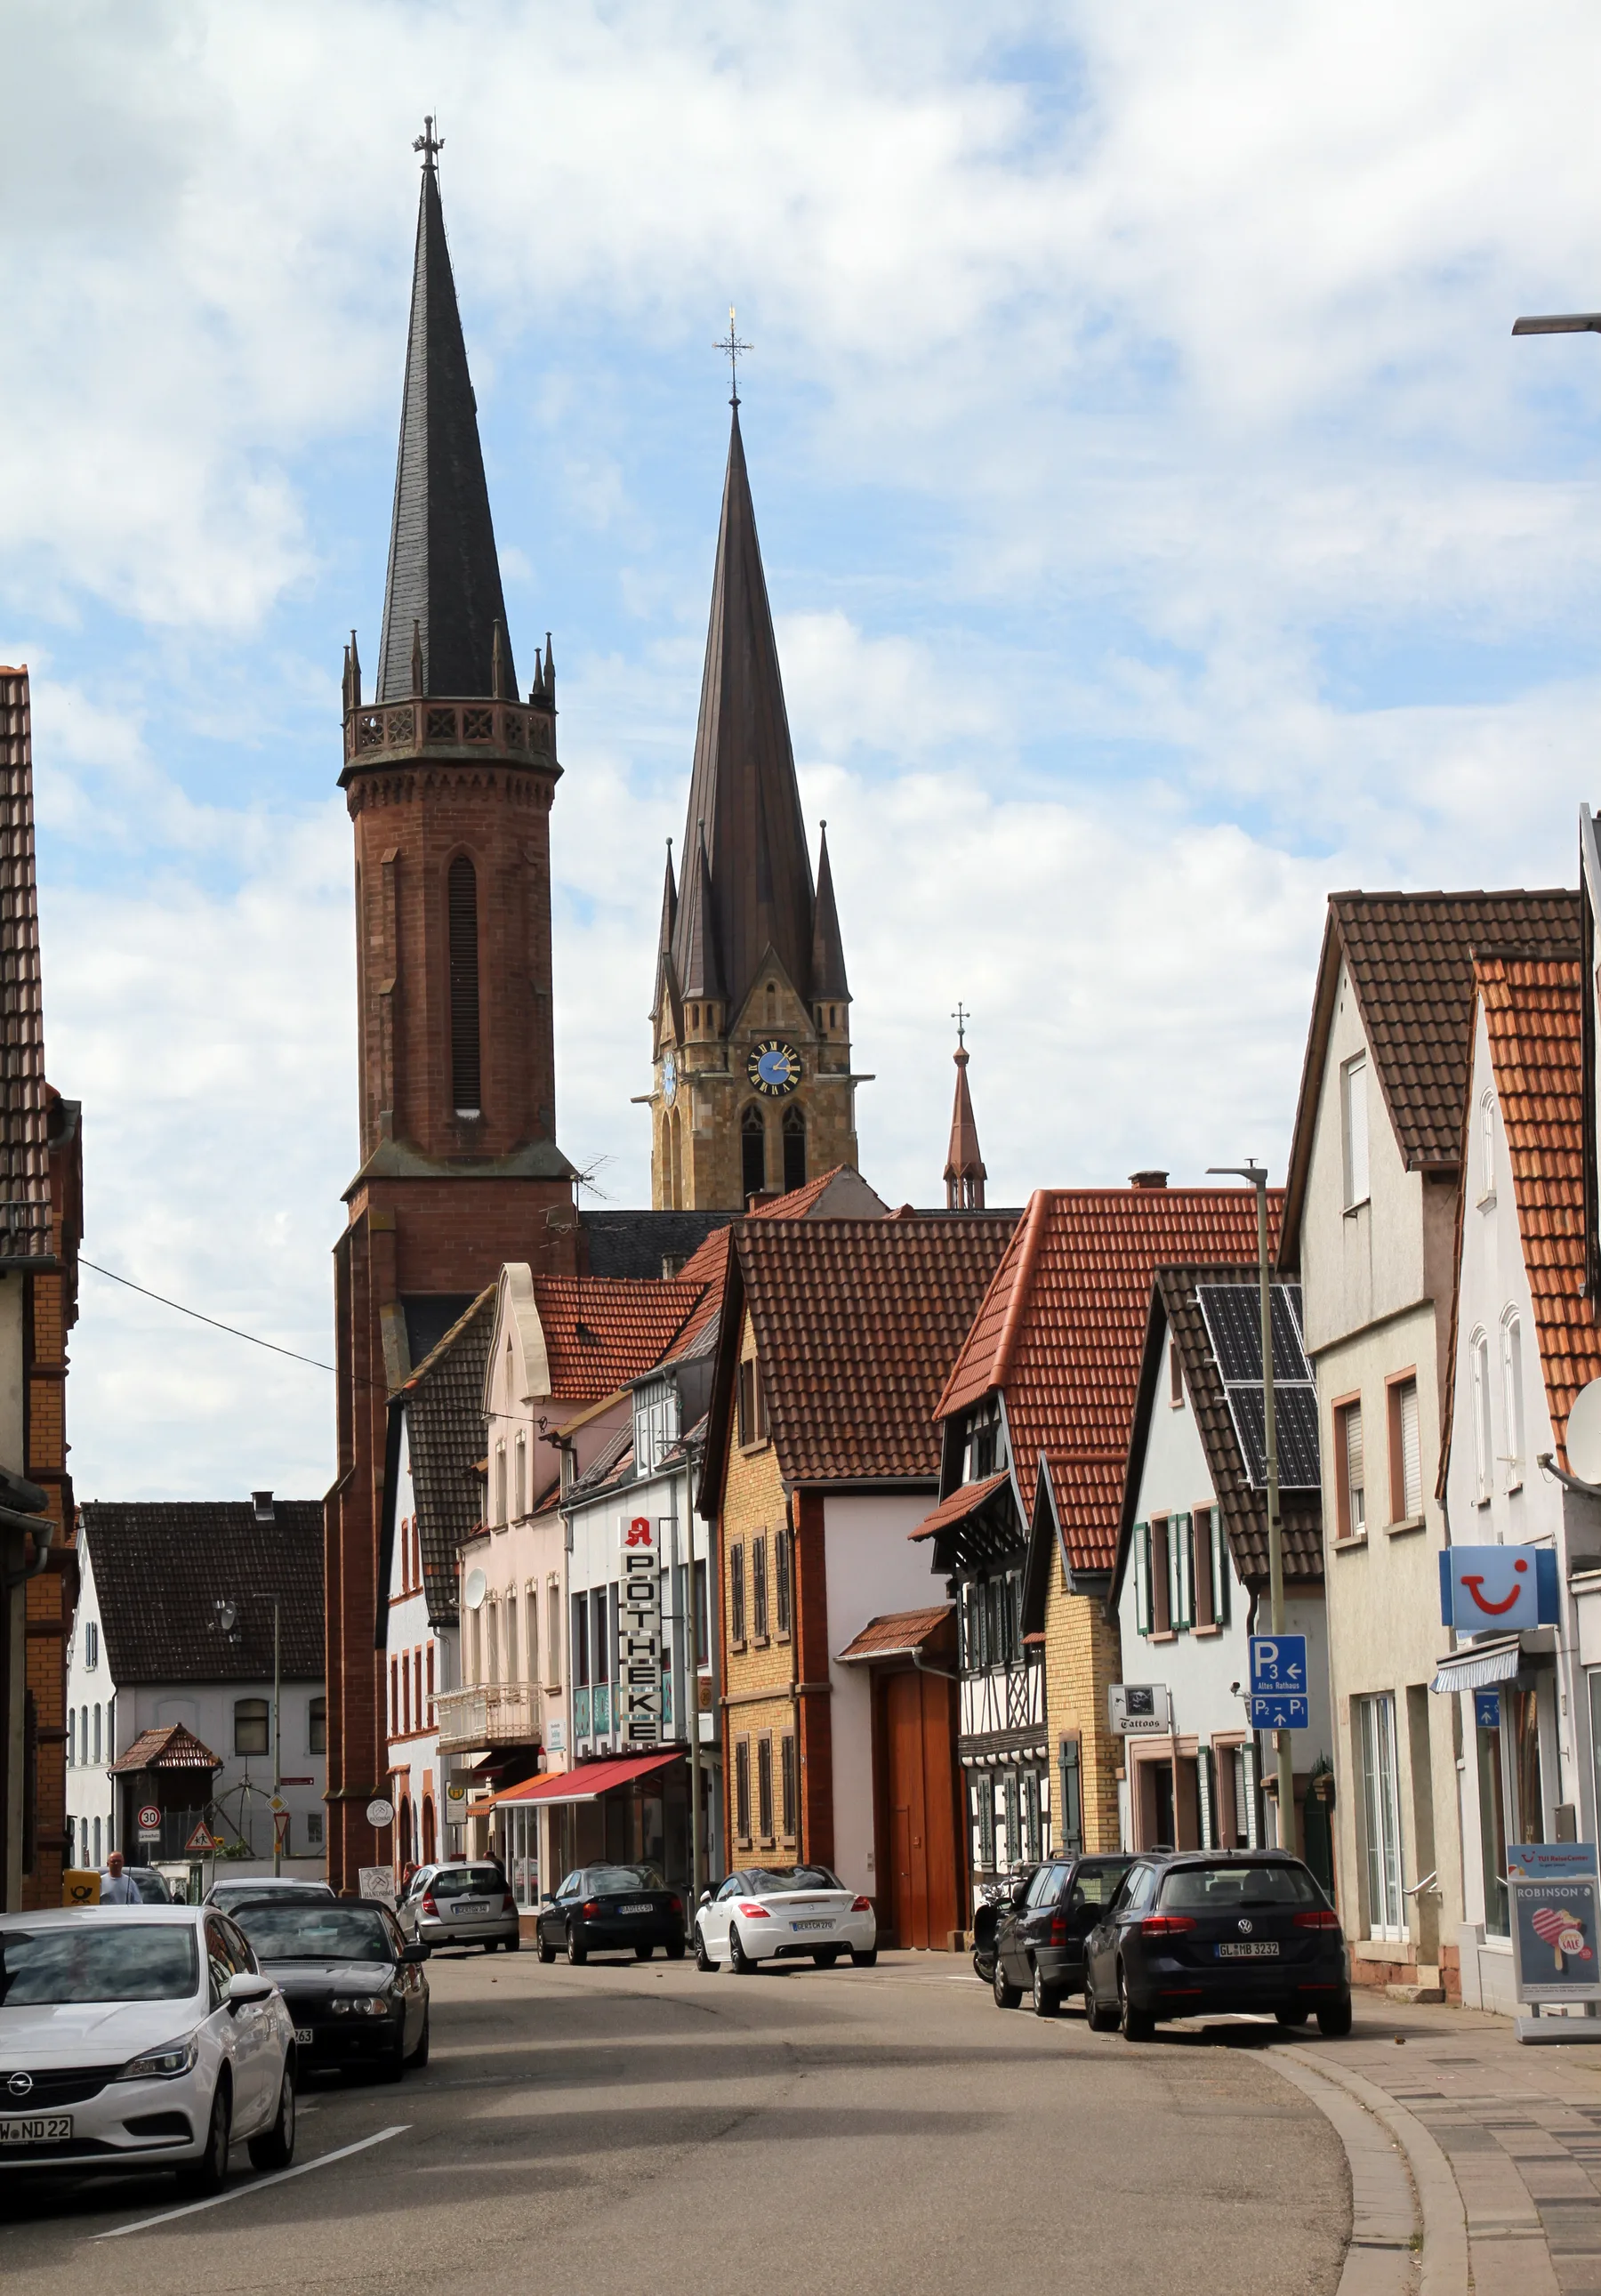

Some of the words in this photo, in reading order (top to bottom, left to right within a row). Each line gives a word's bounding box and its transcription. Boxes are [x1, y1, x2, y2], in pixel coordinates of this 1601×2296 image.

[624, 1516, 658, 1741] APOTHEKE
[1119, 1718, 1160, 1728] Tattoos
[143, 1812, 156, 1823] 30
[1517, 1888, 1578, 1897] ROBINSON
[1220, 1945, 1232, 1955] GL
[1239, 1944, 1252, 1954] MB
[1254, 1943, 1278, 1954] 3232
[1563, 1939, 1580, 1950] SALE
[22, 2121, 44, 2139] ND
[47, 2119, 69, 2137] 22
